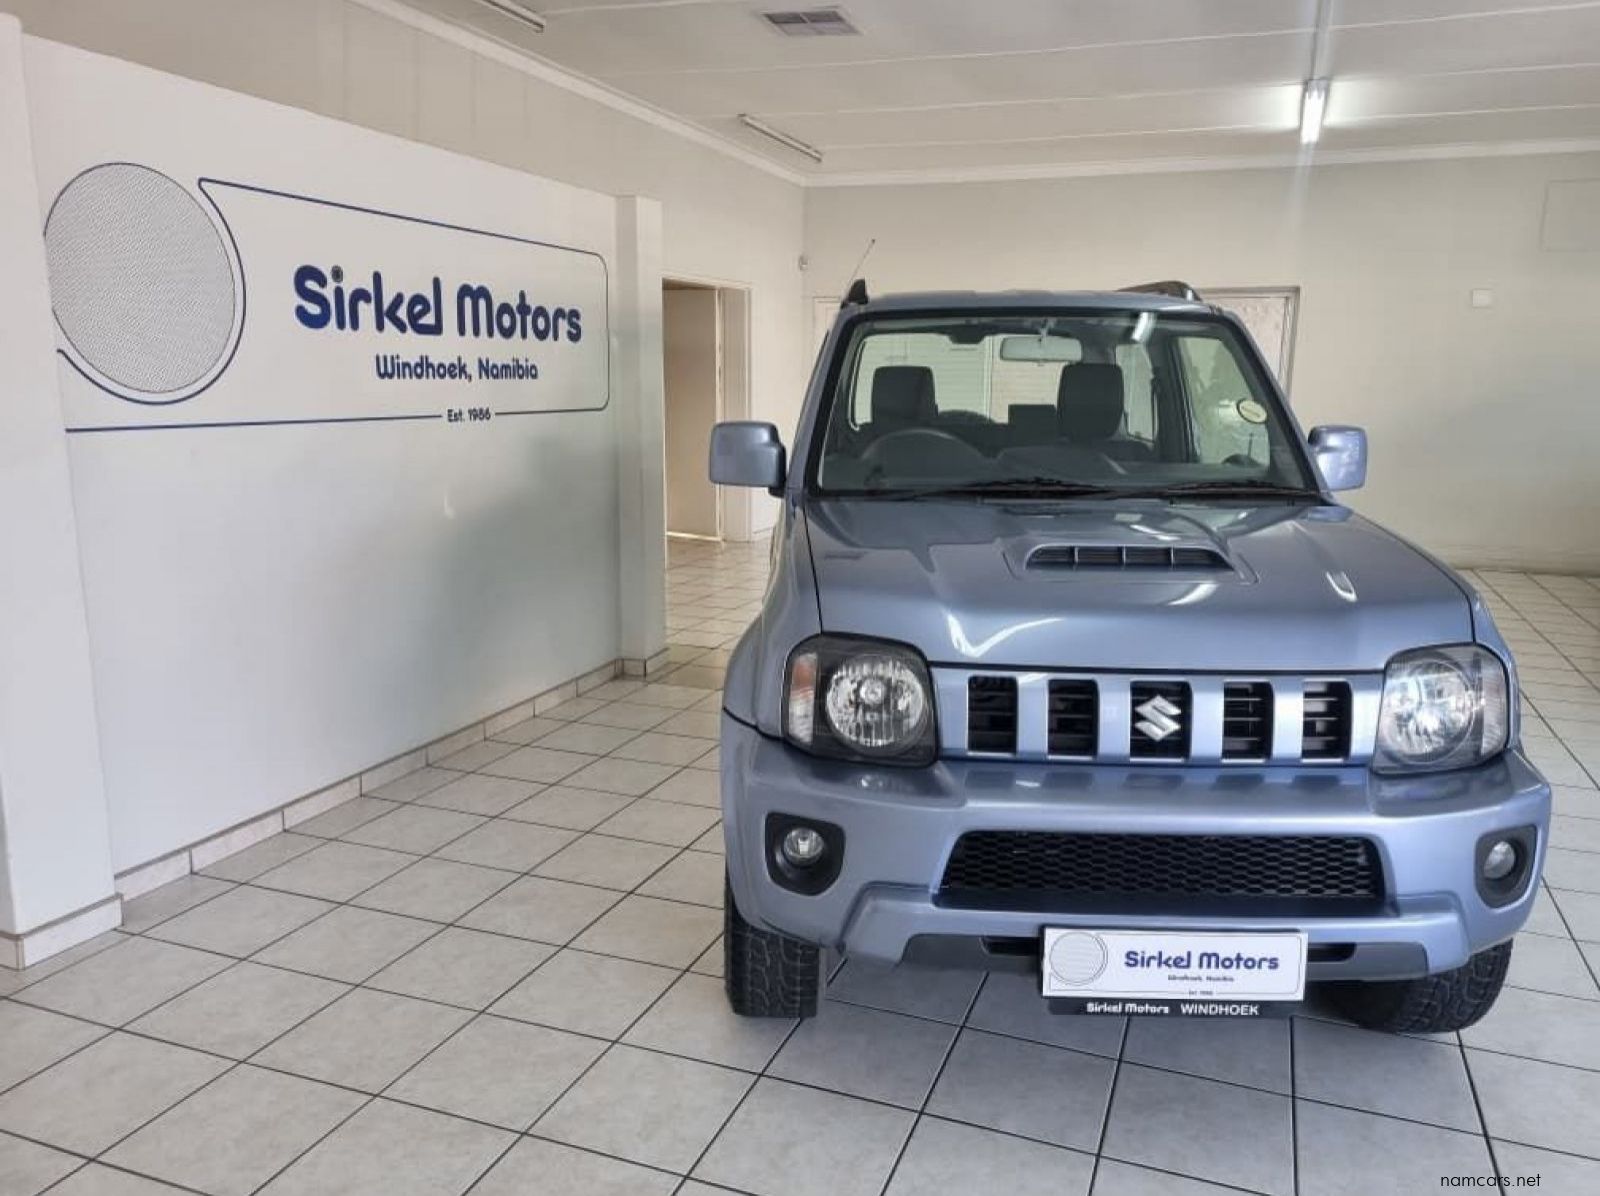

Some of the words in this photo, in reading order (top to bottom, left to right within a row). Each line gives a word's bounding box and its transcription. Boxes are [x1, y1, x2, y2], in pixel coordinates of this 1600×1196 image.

[293, 264, 443, 336] Sirkel
[456, 283, 582, 343] Motors
[375, 353, 473, 383] Windhoek,
[477, 356, 539, 380] Namibia
[447, 408, 466, 423] Est.
[1124, 950, 1192, 970] Sirkel
[1198, 952, 1280, 970] Motors
[1086, 1002, 1122, 1013] Sirkel
[1124, 1002, 1169, 1014] Motors
[1180, 1003, 1259, 1015] WINDHOEK
